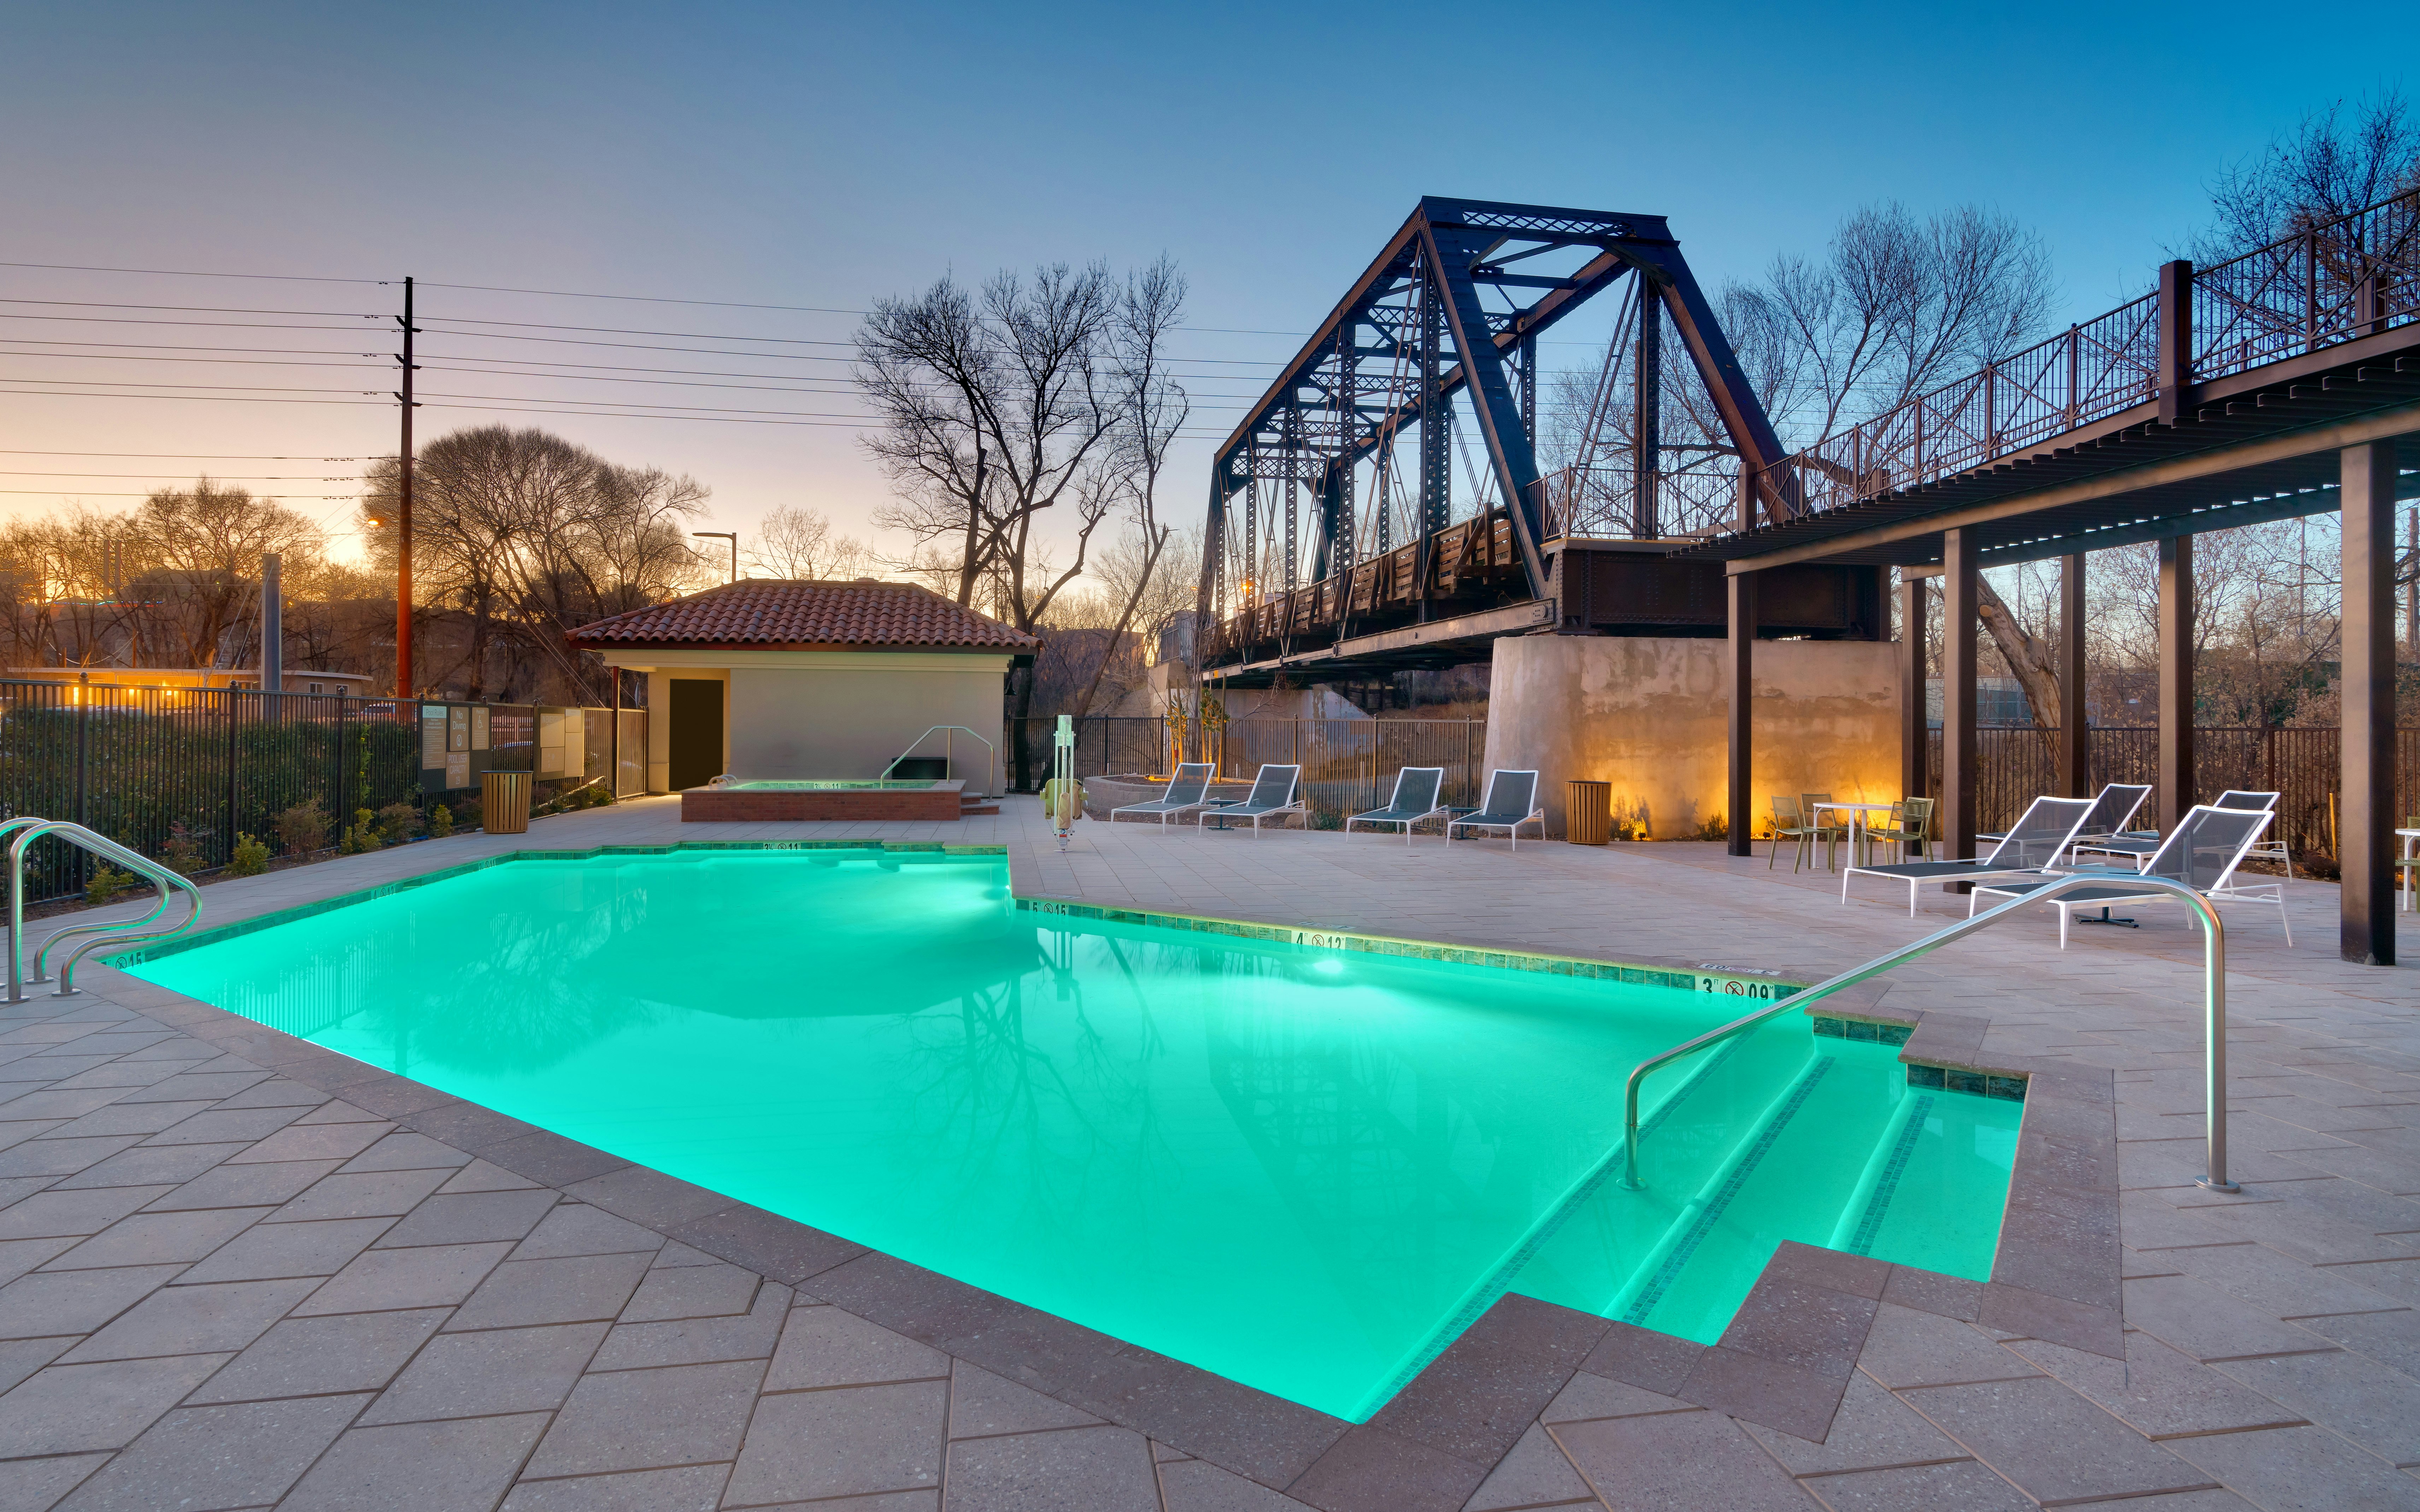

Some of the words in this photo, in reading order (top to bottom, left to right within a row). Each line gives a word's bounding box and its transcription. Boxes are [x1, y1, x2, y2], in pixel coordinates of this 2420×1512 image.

[457, 710, 463, 719] No
[453, 721, 466, 731] Diving
[448, 755, 458, 763] POOL
[459, 754, 468, 763] USER
[450, 764, 466, 774] CAPACITY
[1033, 902, 1038, 912] 5
[1297, 932, 1303, 945] 4
[1703, 978, 1712, 993] 3
